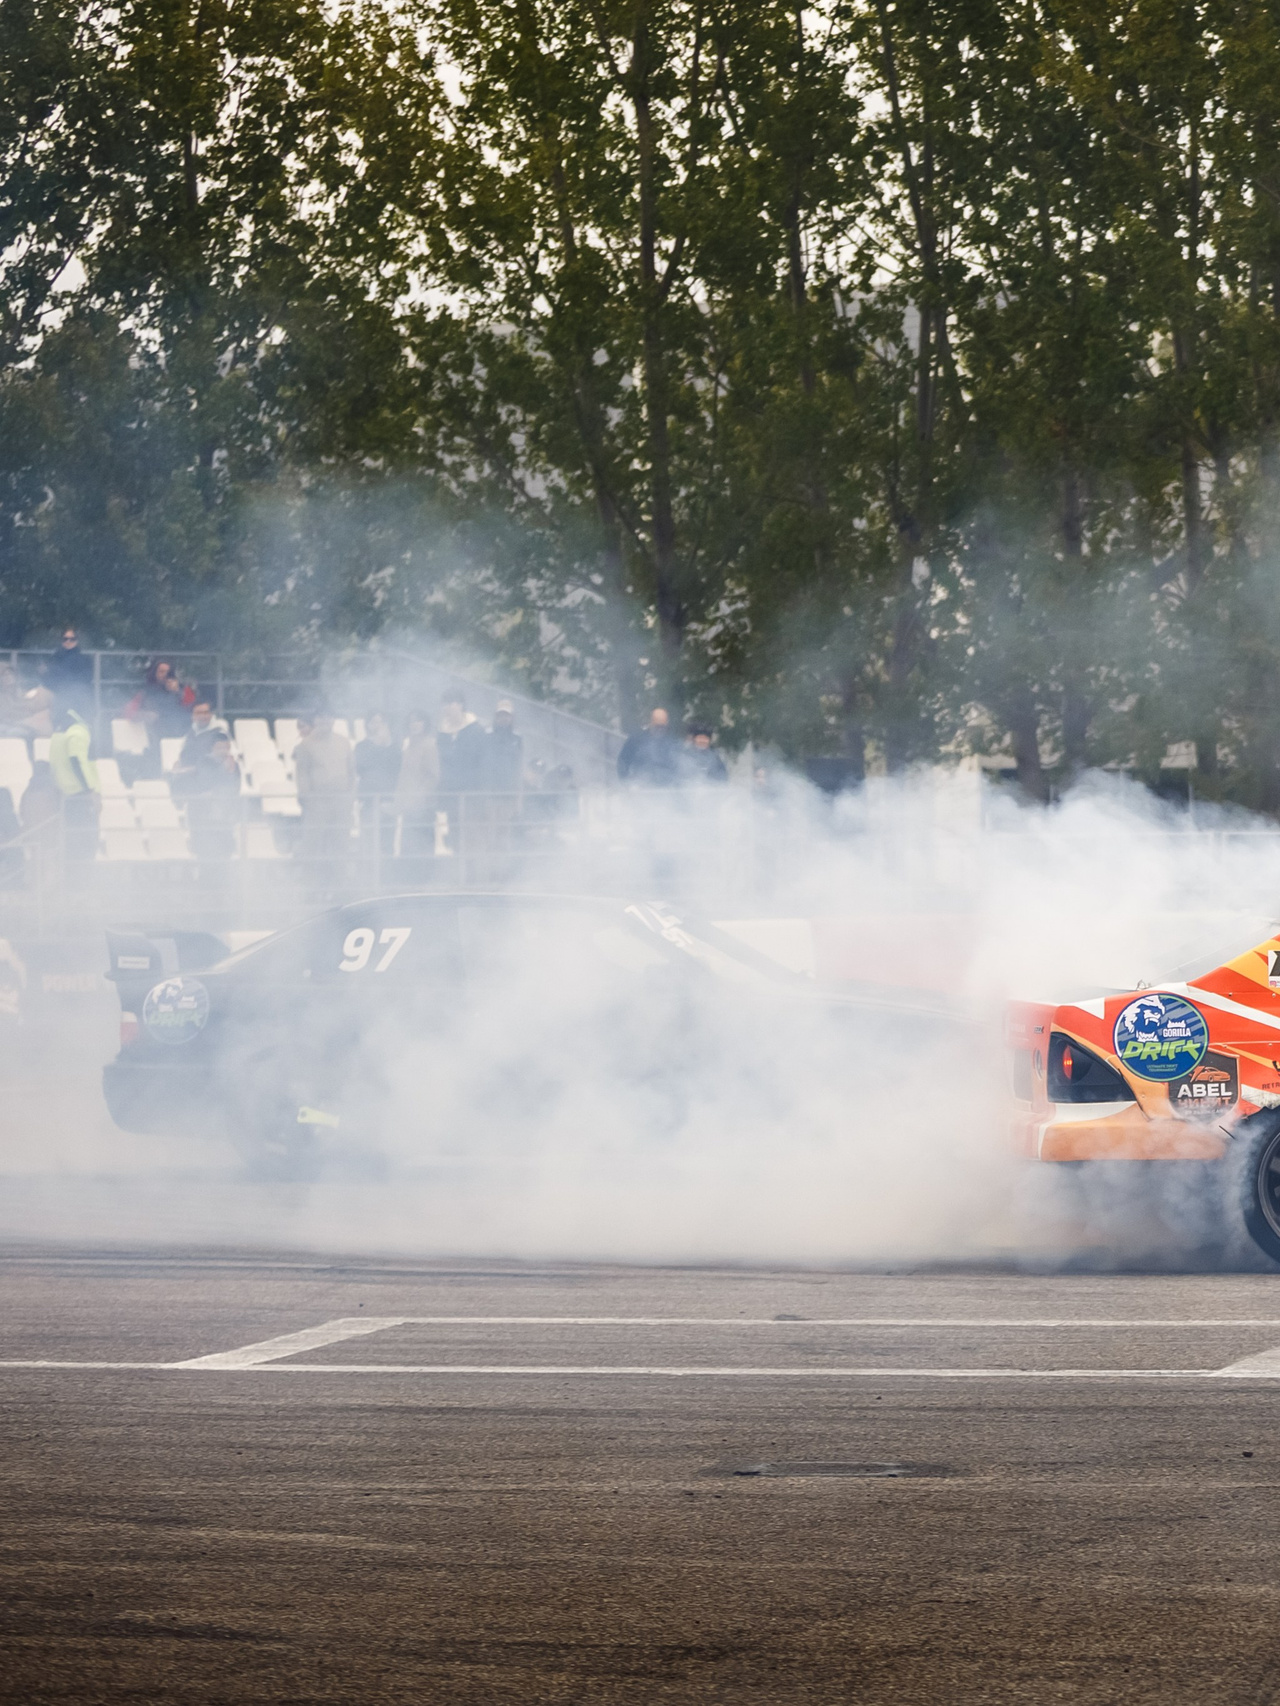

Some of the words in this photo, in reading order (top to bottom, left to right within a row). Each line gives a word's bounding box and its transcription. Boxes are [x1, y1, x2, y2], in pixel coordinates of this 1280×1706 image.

[338, 927, 412, 973] 97
[1163, 1028, 1192, 1038] GORILLA
[1122, 1040, 1201, 1061] DRIFT
[1177, 1083, 1233, 1098] ABEL
